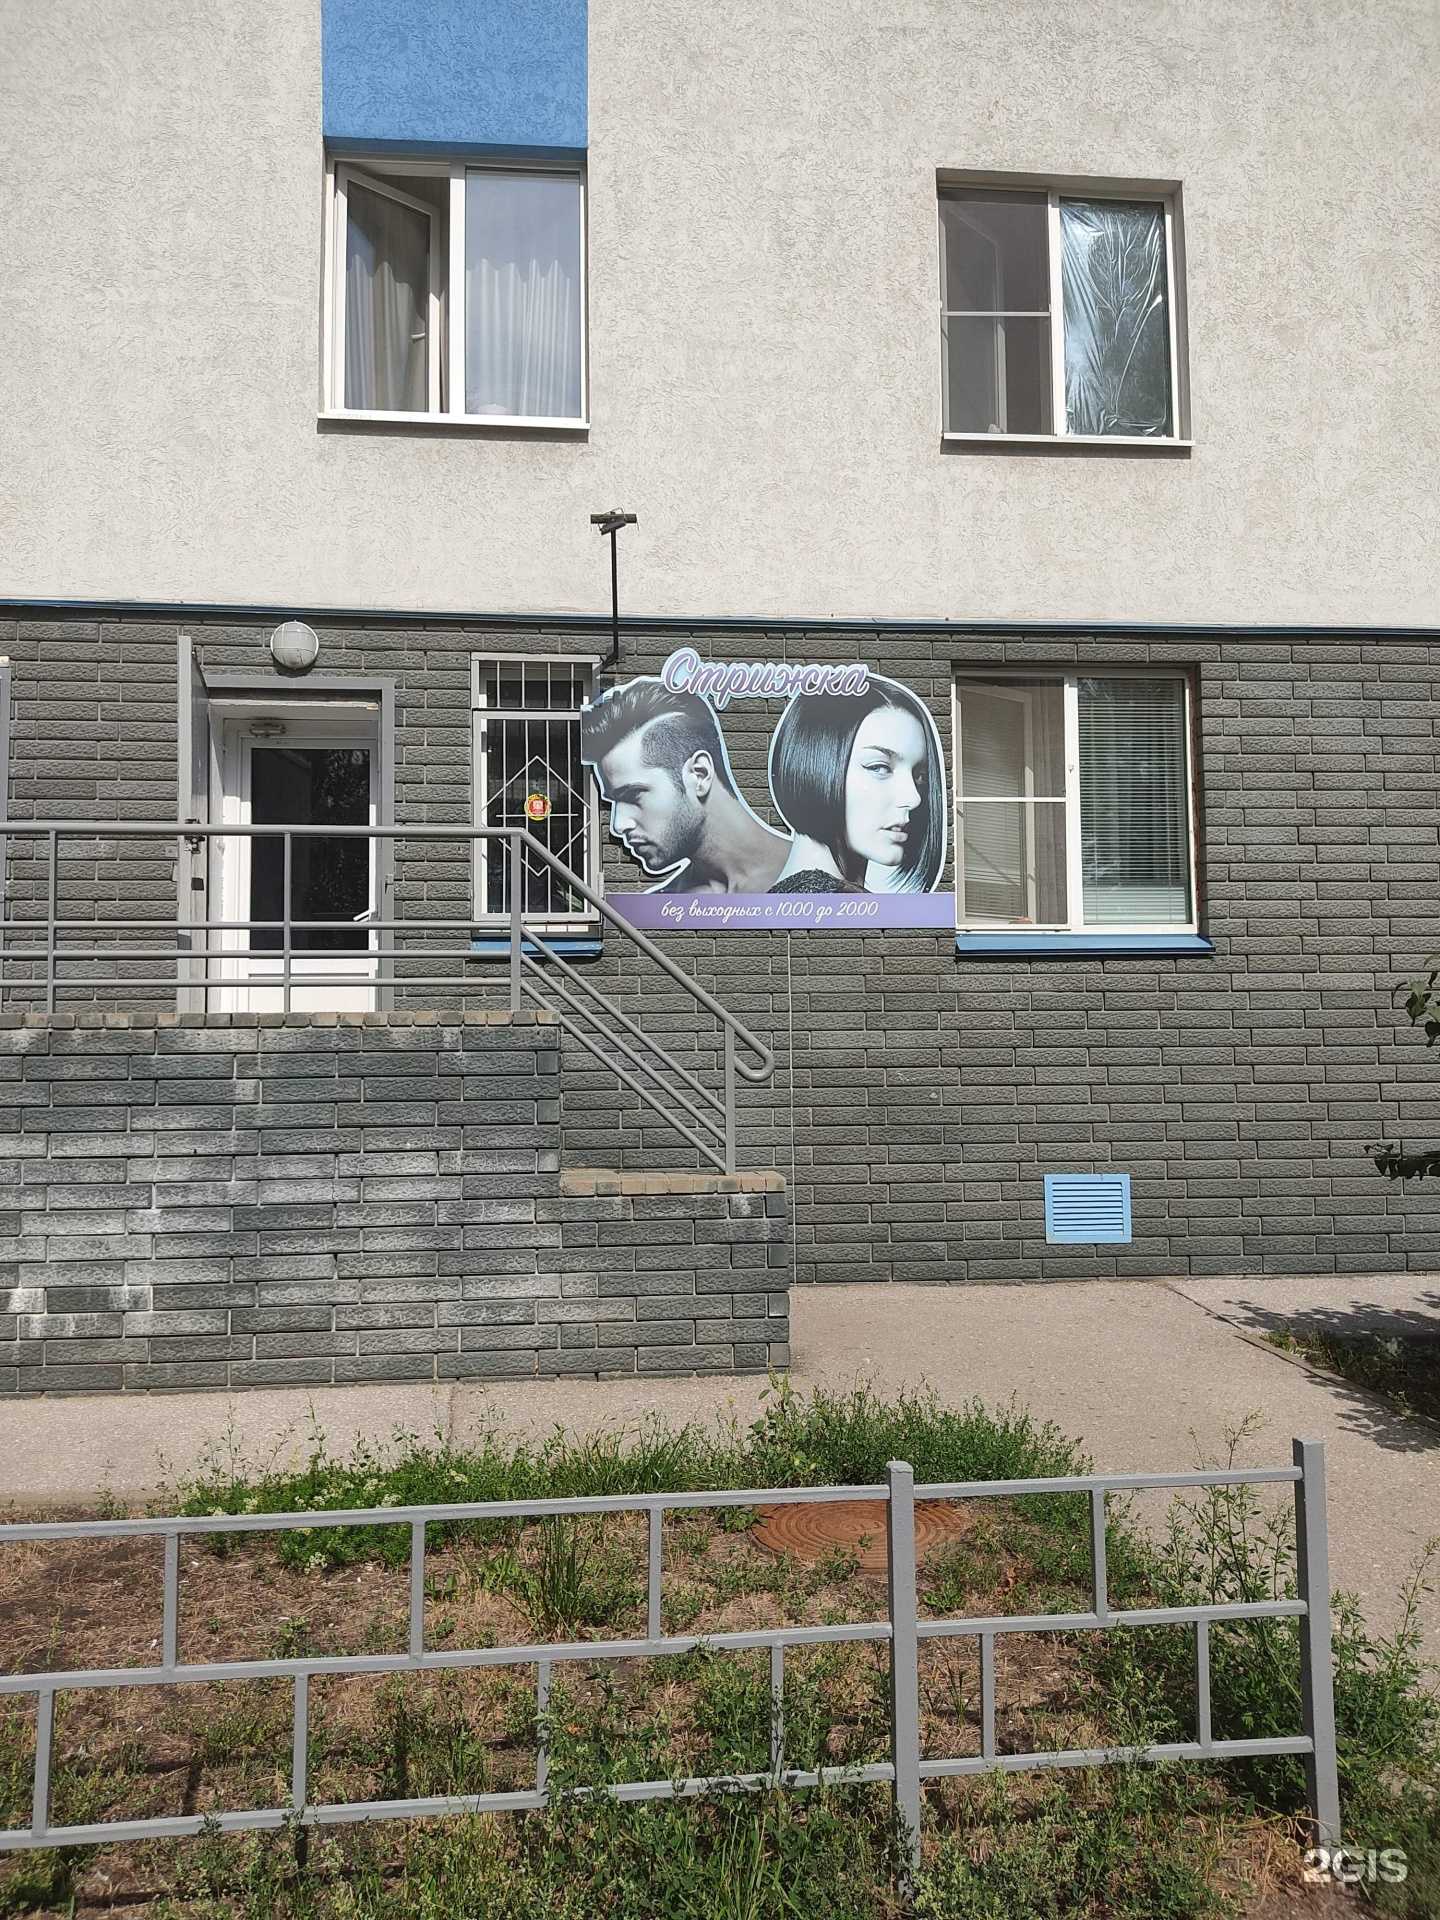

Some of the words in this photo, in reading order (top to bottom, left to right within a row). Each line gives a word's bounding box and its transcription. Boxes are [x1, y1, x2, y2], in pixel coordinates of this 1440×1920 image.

[663, 649, 869, 709] Стрижка
[661, 901, 684, 921] без
[689, 899, 761, 923] выходных
[764, 905, 773, 916] с
[815, 904, 832, 922] до
